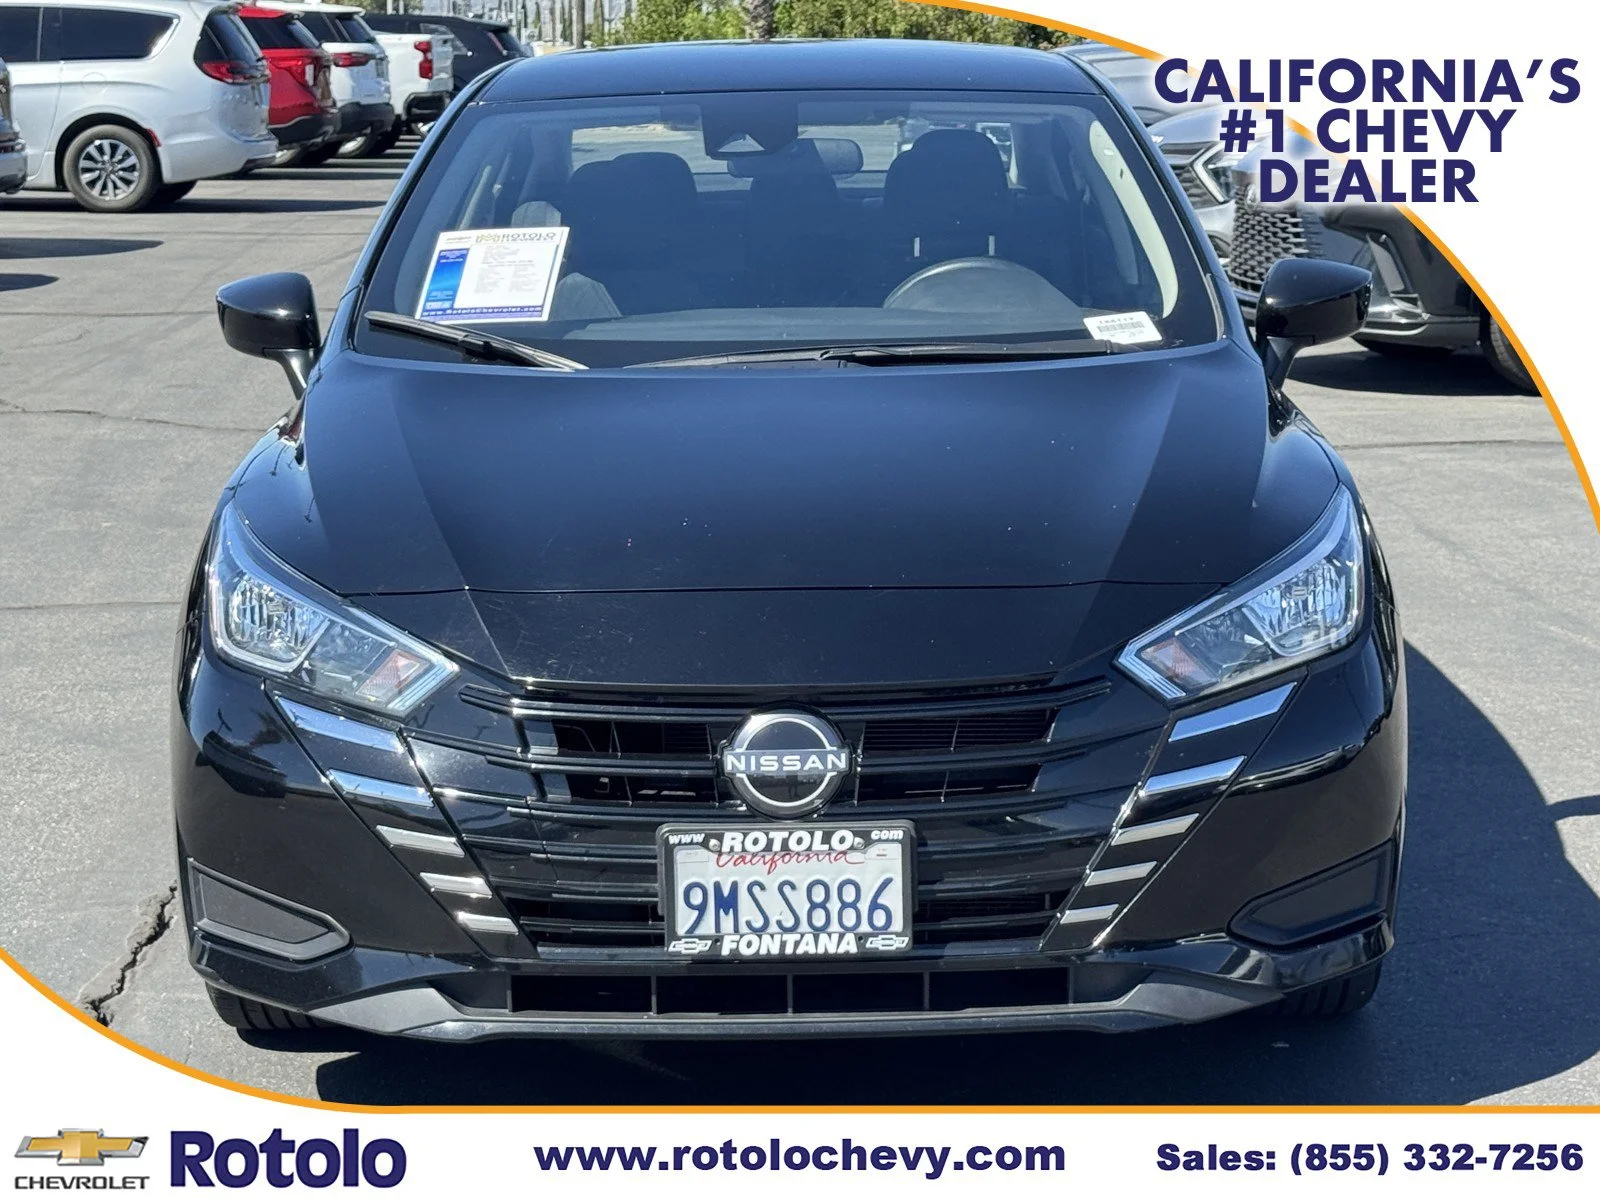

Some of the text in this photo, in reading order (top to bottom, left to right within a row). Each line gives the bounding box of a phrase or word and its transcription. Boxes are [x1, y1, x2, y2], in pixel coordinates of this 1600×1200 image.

[726, 752, 847, 772] NISSAN
[668, 829, 905, 853] www ROTOLO com
[715, 849, 865, 876] California
[682, 876, 895, 935] 9MSS886
[720, 932, 859, 957] FONTANA
